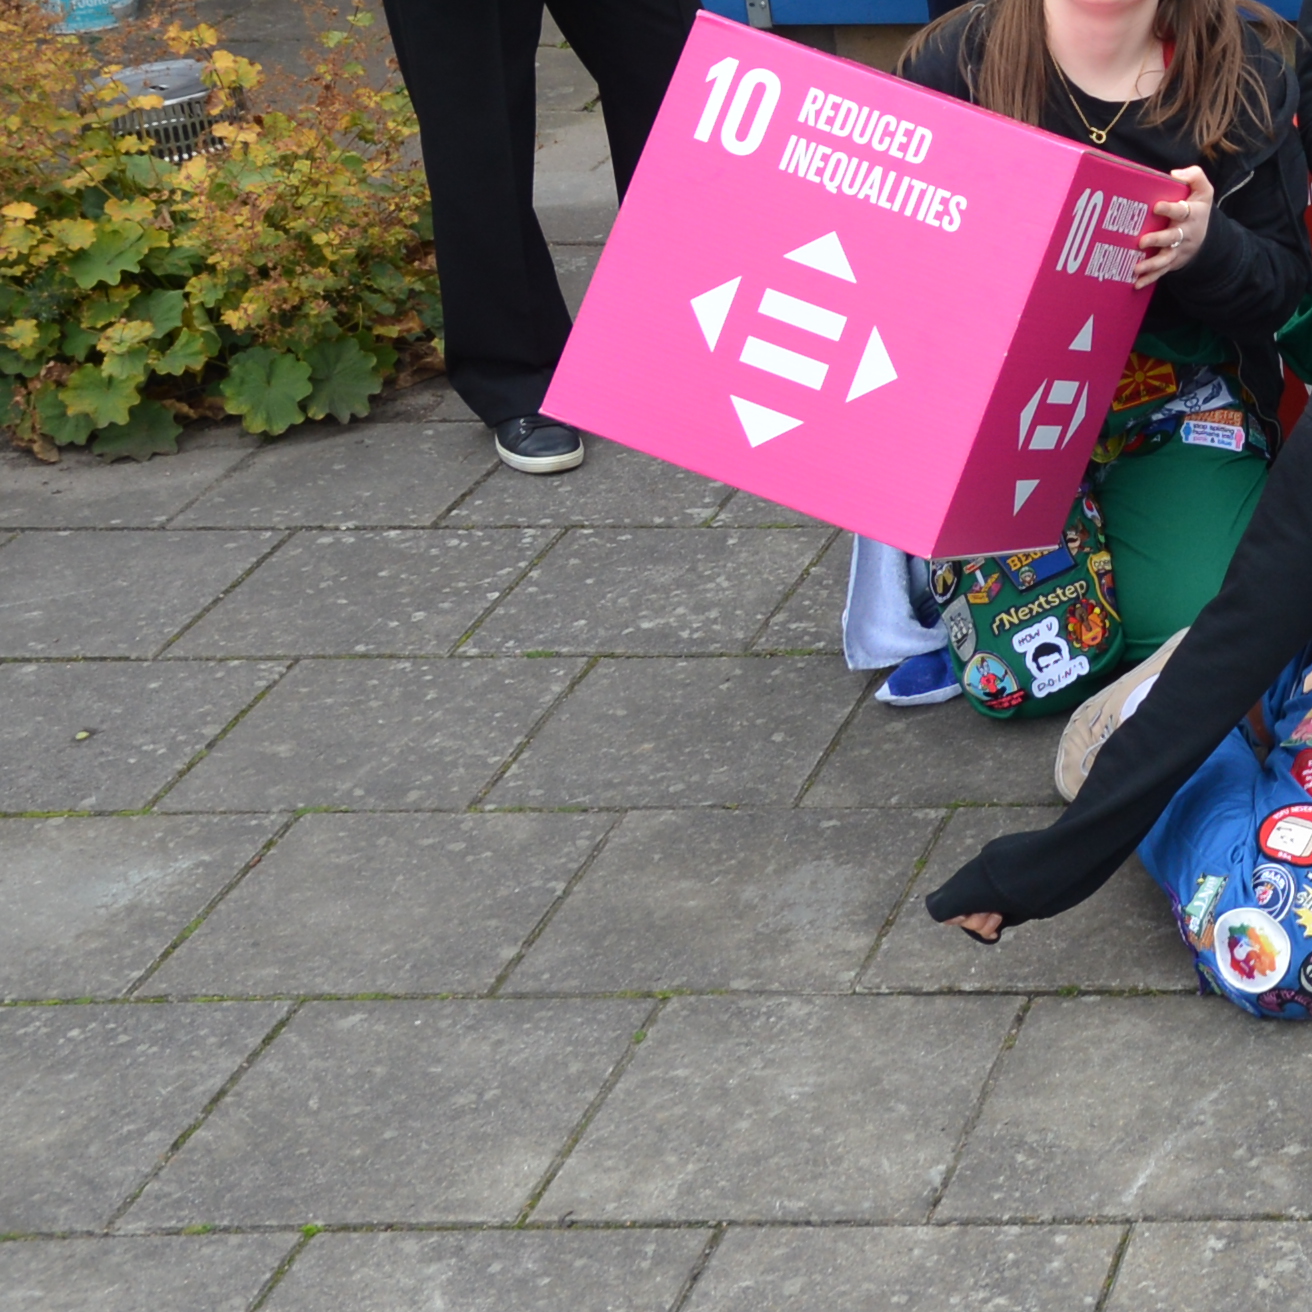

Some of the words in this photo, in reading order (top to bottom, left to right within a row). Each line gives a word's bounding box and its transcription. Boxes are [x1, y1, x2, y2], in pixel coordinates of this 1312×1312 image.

[693, 55, 782, 158] 10
[797, 85, 934, 166] REDUCED
[778, 134, 968, 234] INEQUALITIES
[1055, 187, 1105, 275] 10
[1101, 194, 1149, 237] REDUCED
[1000, 580, 1088, 630] Nextstep
